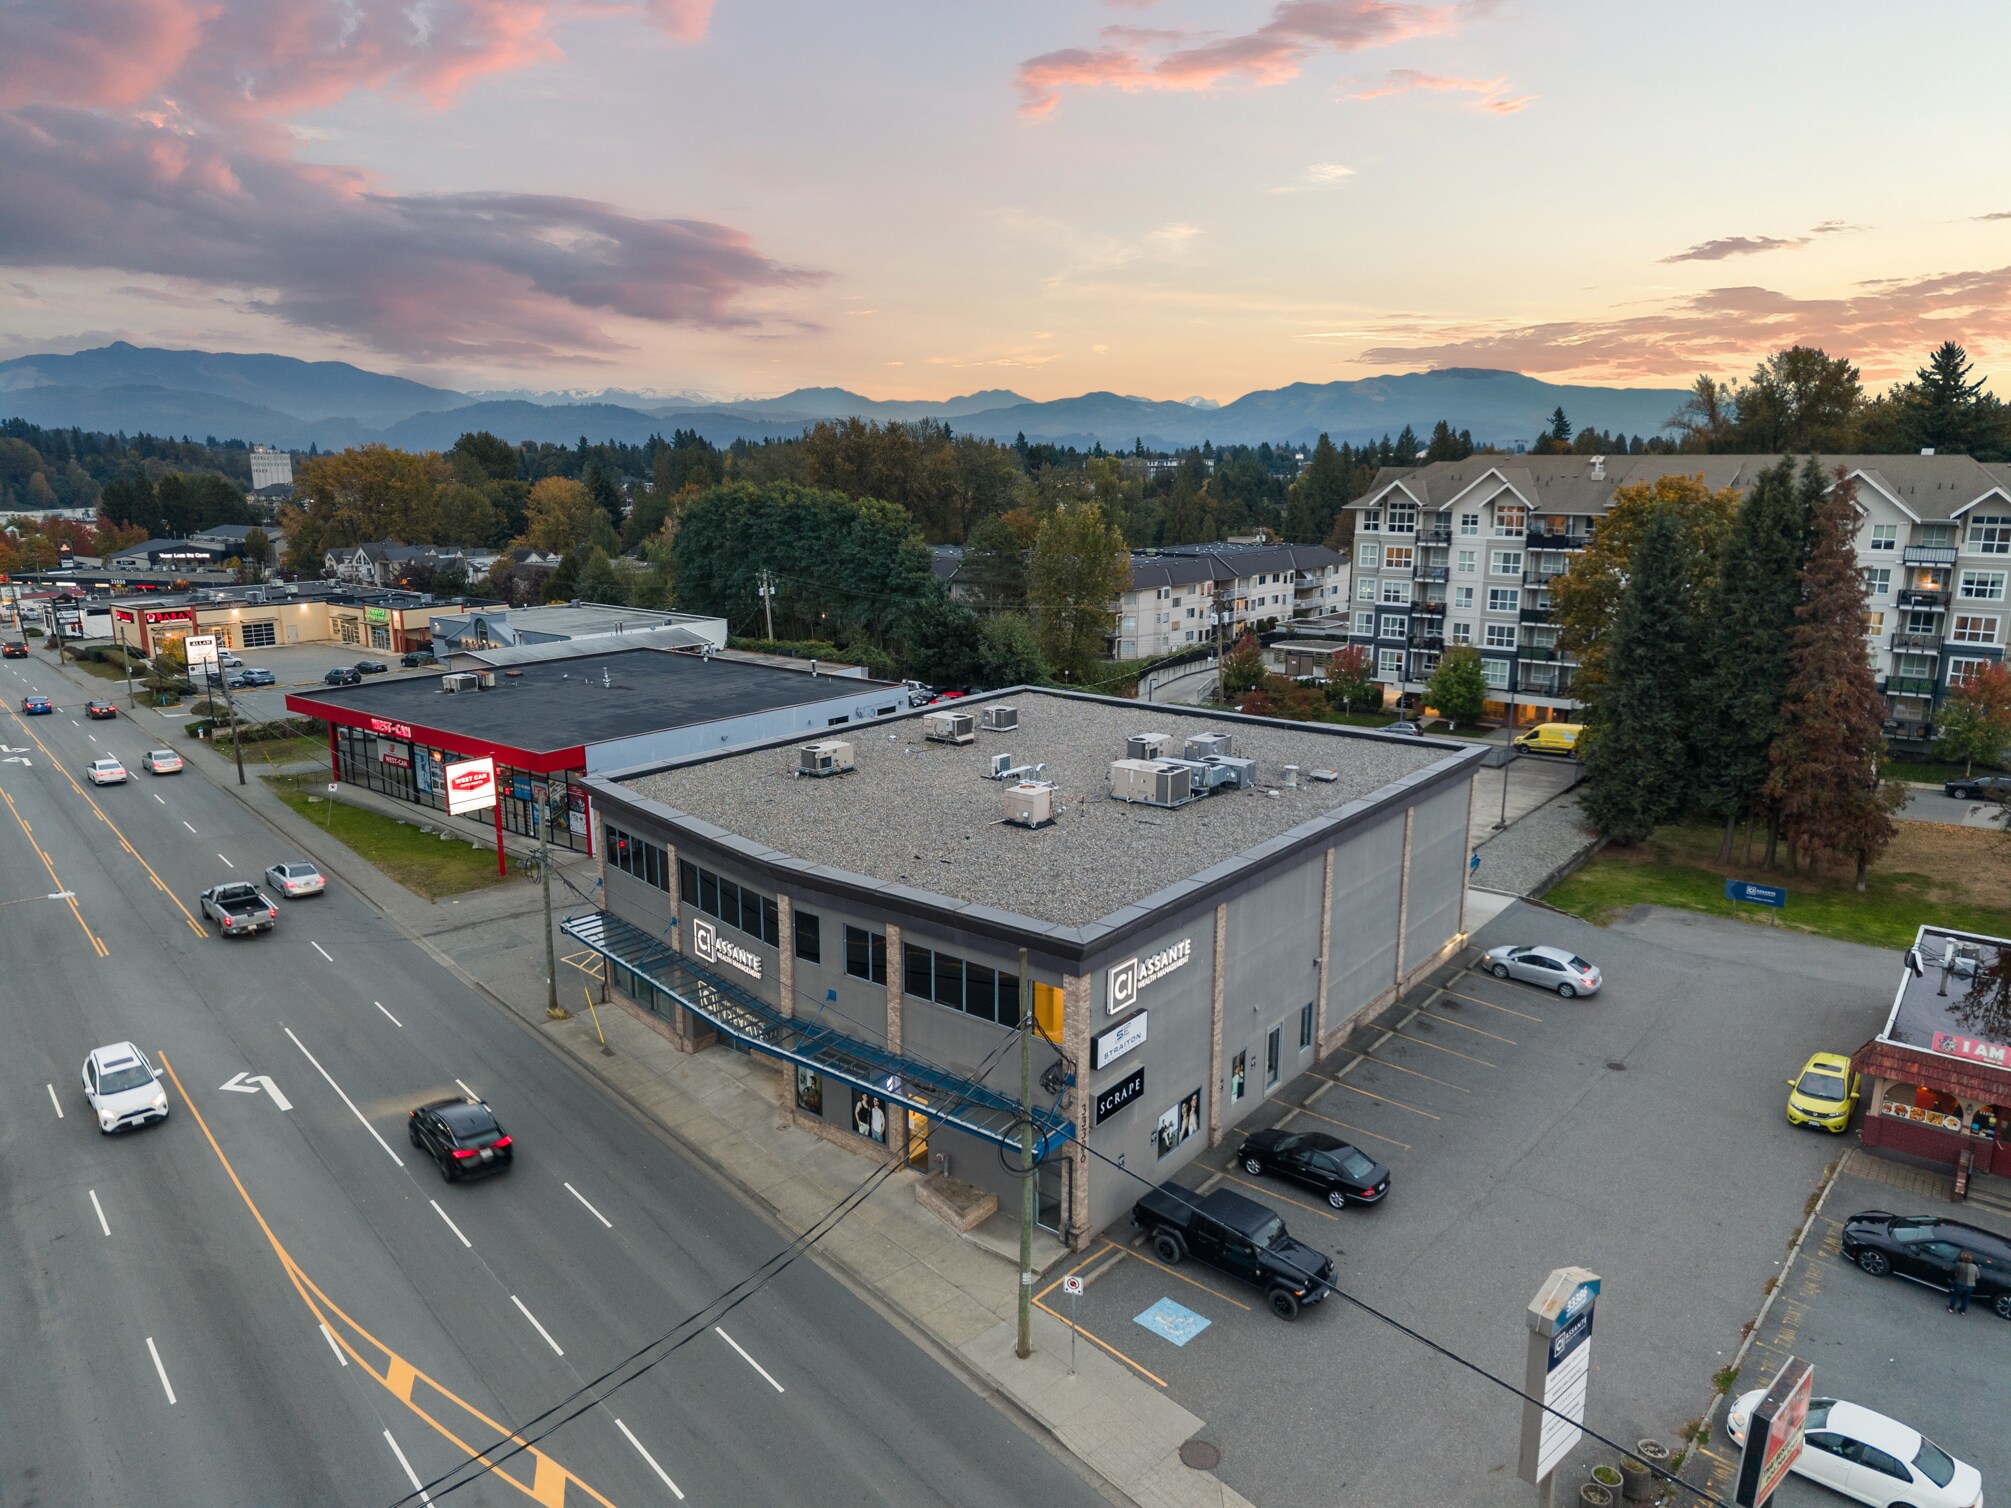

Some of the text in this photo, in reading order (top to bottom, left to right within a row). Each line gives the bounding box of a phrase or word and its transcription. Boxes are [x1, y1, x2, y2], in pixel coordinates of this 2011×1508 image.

[371, 718, 412, 738] WEST-CAN
[385, 755, 408, 768] WEST-CAN
[455, 773, 487, 785] WEST CAN
[697, 929, 711, 953] CI
[715, 938, 762, 972] ASSANTE
[1138, 938, 1191, 981] ASSANTE
[1137, 954, 1190, 989] WEALTH MANAGEMENT
[1114, 970, 1133, 1000] CI
[1103, 1032, 1142, 1061] STRAITON
[1962, 1040, 2006, 1061] I AM
[1100, 1078, 1141, 1115] SCRAPE
[1565, 1316, 1587, 1339] ASSANTE
